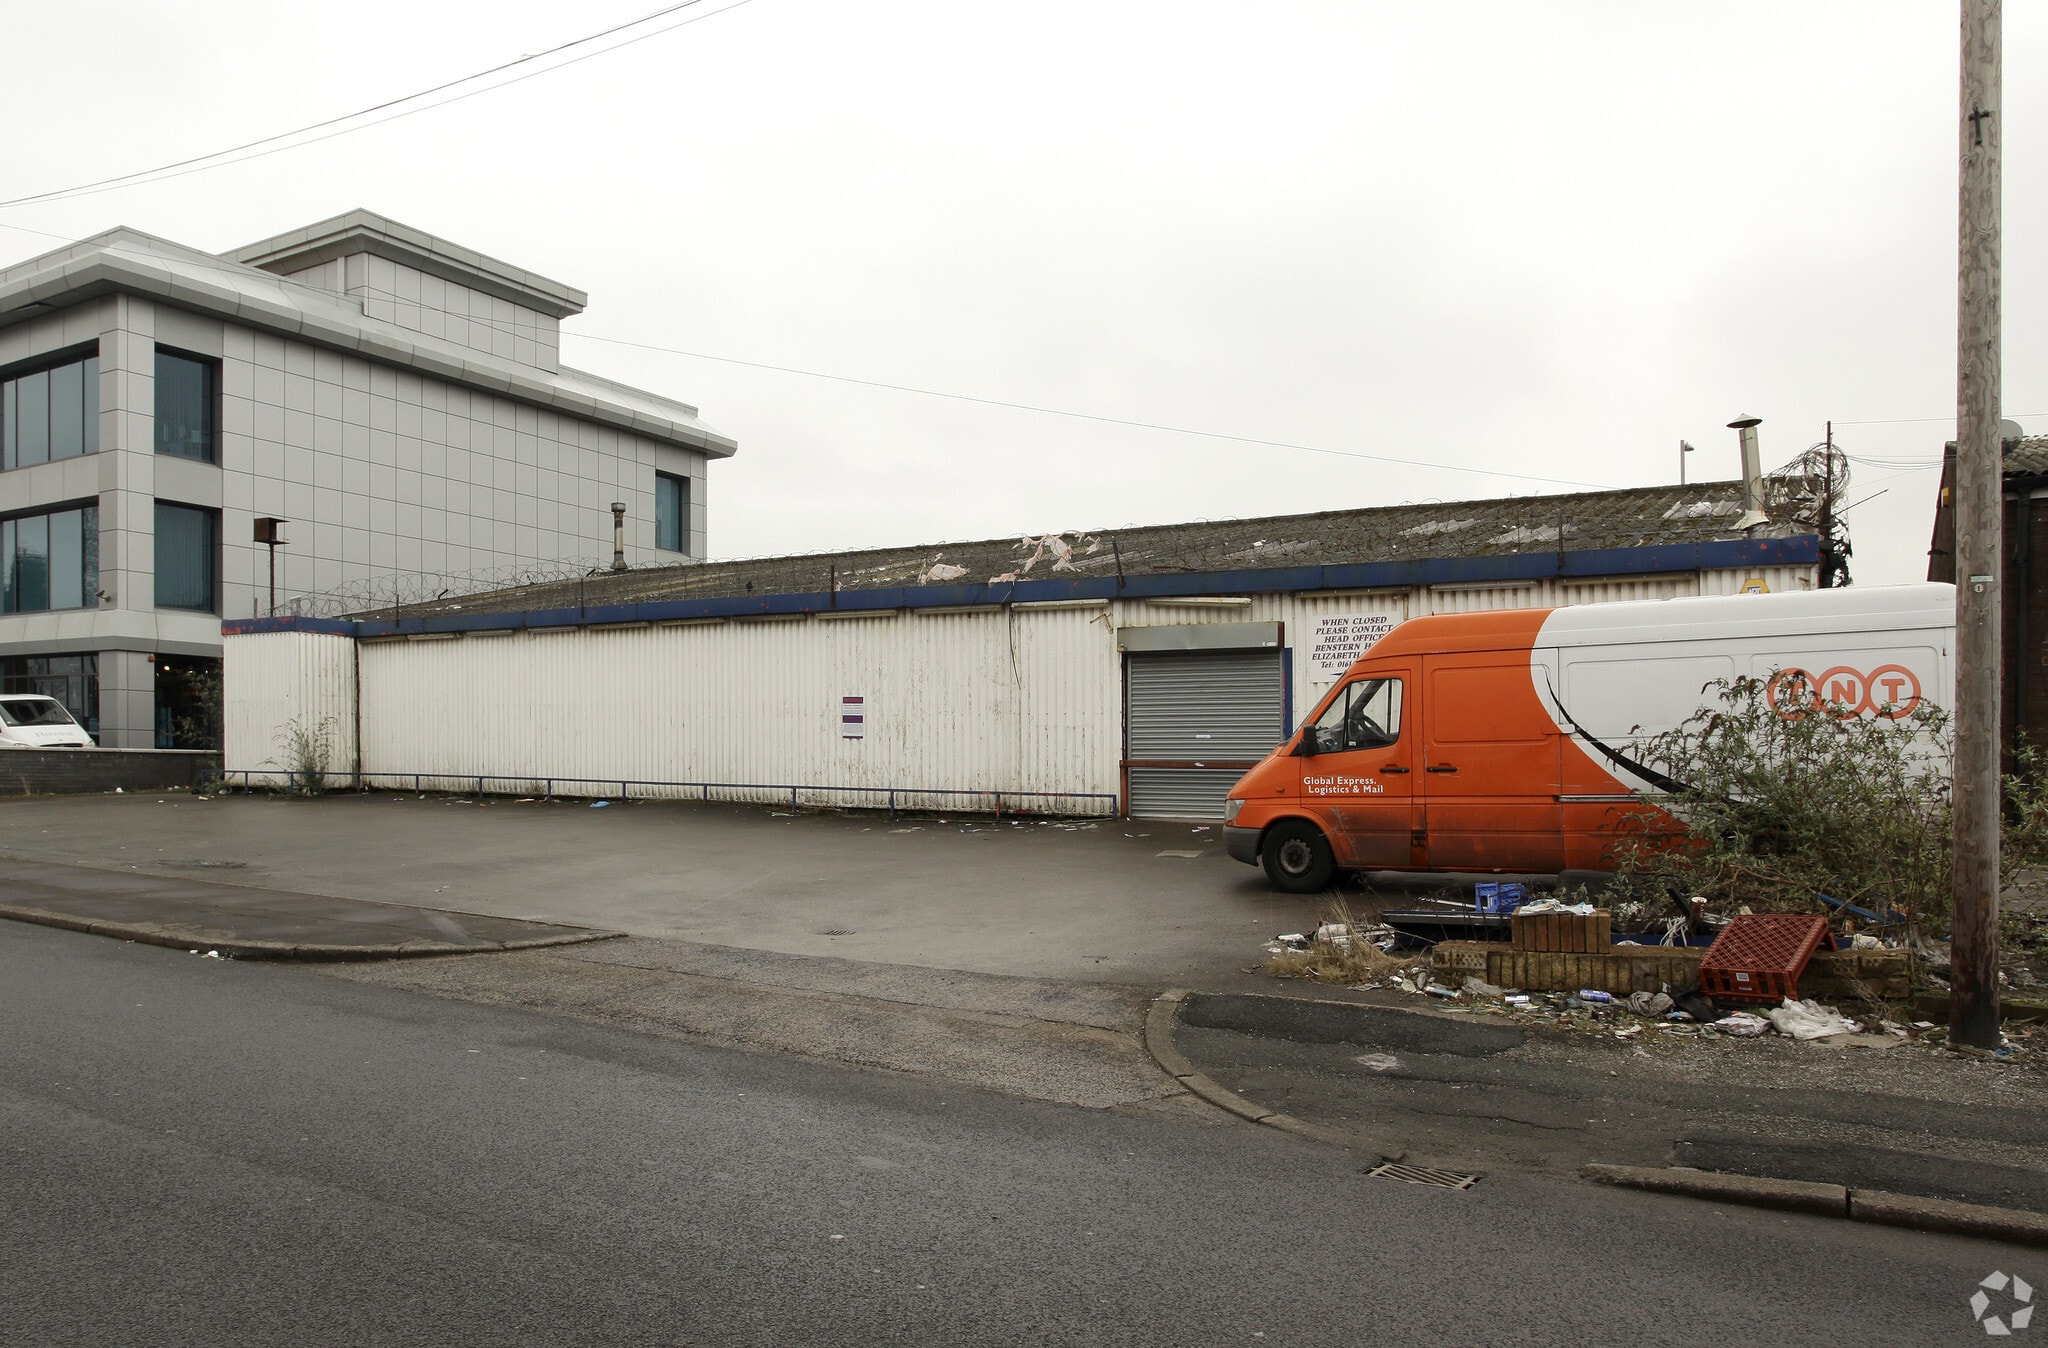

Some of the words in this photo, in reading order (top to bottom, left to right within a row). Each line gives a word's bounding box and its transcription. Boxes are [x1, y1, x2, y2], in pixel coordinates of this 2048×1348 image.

[1322, 618, 1349, 626] WHEN
[1353, 616, 1387, 625] CLOSED
[1316, 627, 1348, 635] PLEASE
[1352, 625, 1393, 634] CONTACT
[1324, 635, 1349, 643] HEAD
[1315, 643, 1361, 652] BENSTERN
[1312, 652, 1360, 660] ELIZABETH
[1303, 776, 1334, 785] Global
[1337, 776, 1377, 787] Express.
[1308, 785, 1349, 796] Logistics
[1352, 785, 1360, 793] &
[1363, 785, 1384, 793] Mail
